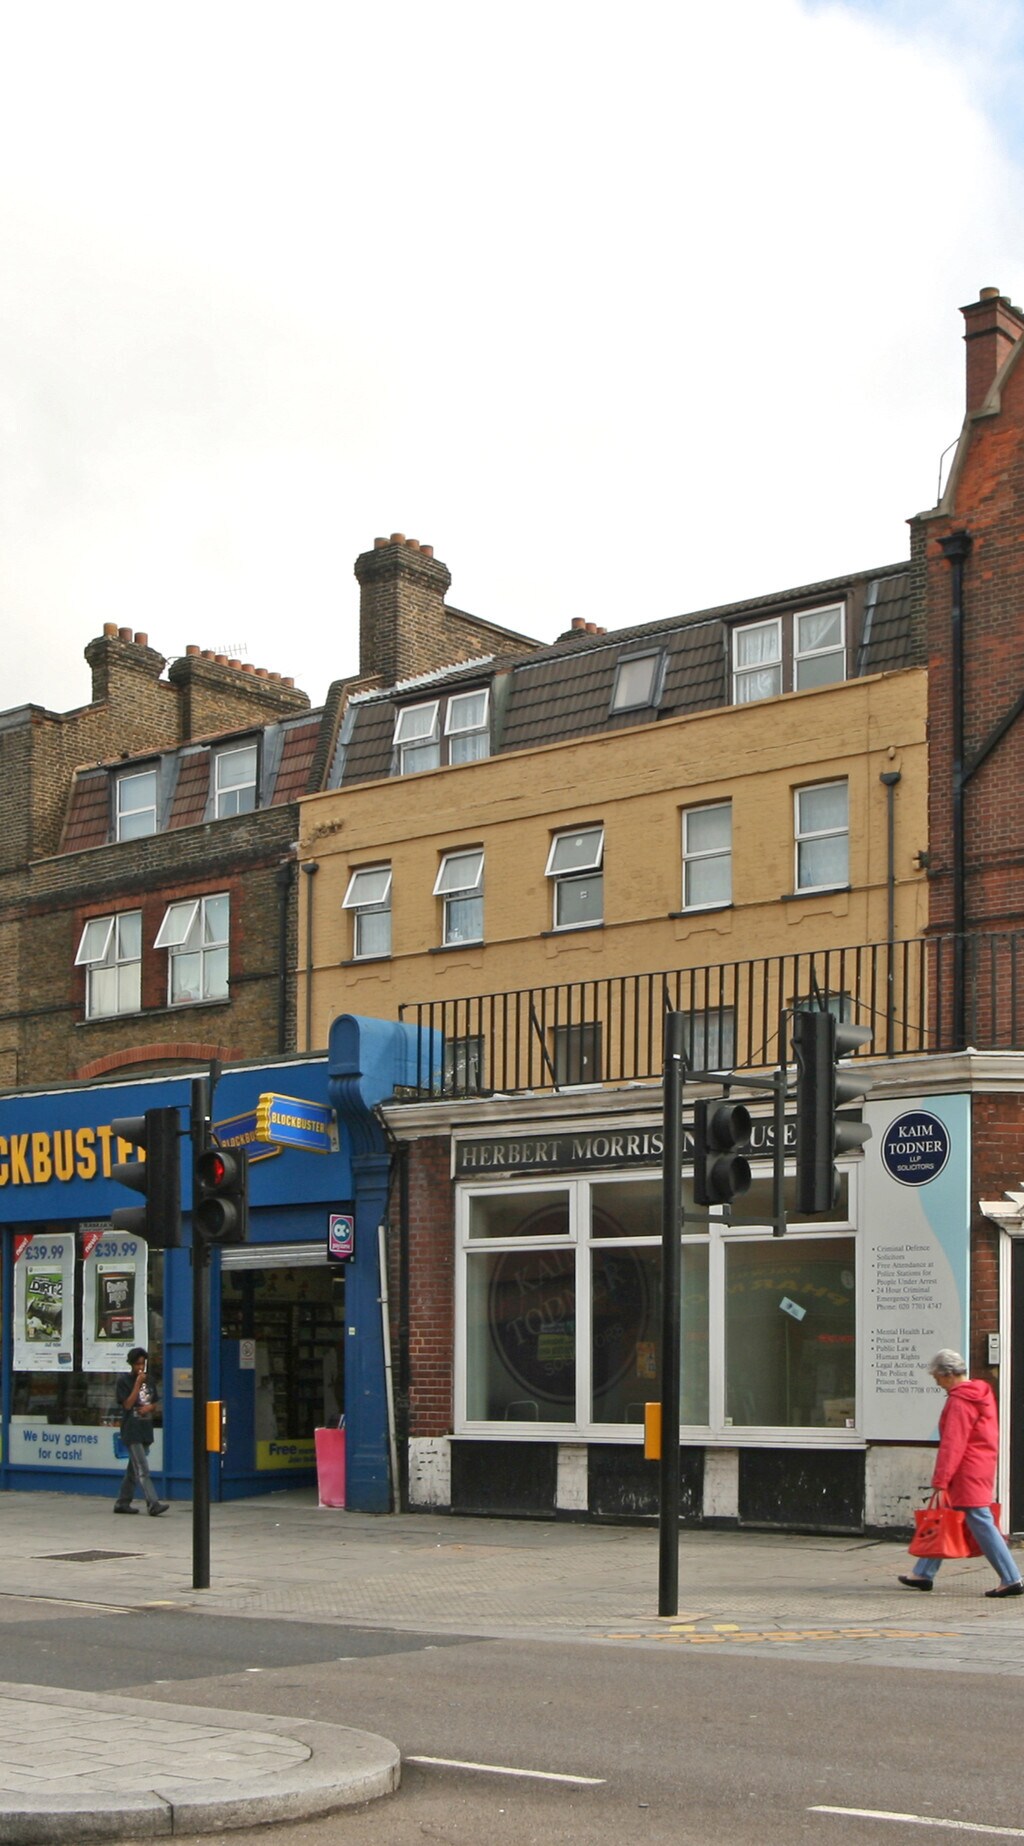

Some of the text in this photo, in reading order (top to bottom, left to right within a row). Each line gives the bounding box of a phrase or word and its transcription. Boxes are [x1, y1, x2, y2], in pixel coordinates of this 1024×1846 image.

[271, 1112, 325, 1133] BLOCKBUSTER
[898, 1124, 933, 1138] KAIM
[221, 1130, 258, 1148] BLOCKBU
[462, 1140, 562, 1167] HERBERT
[571, 1131, 695, 1161] MORRISN
[888, 1141, 943, 1155] TODNER
[897, 1163, 934, 1171] SOLICITORS
[25, 1245, 64, 1260] £39.99
[95, 1242, 138, 1257] £39.99
[23, 1430, 98, 1445] We buy games
[39, 1448, 82, 1460] for cash!
[269, 1443, 297, 1456] Free
